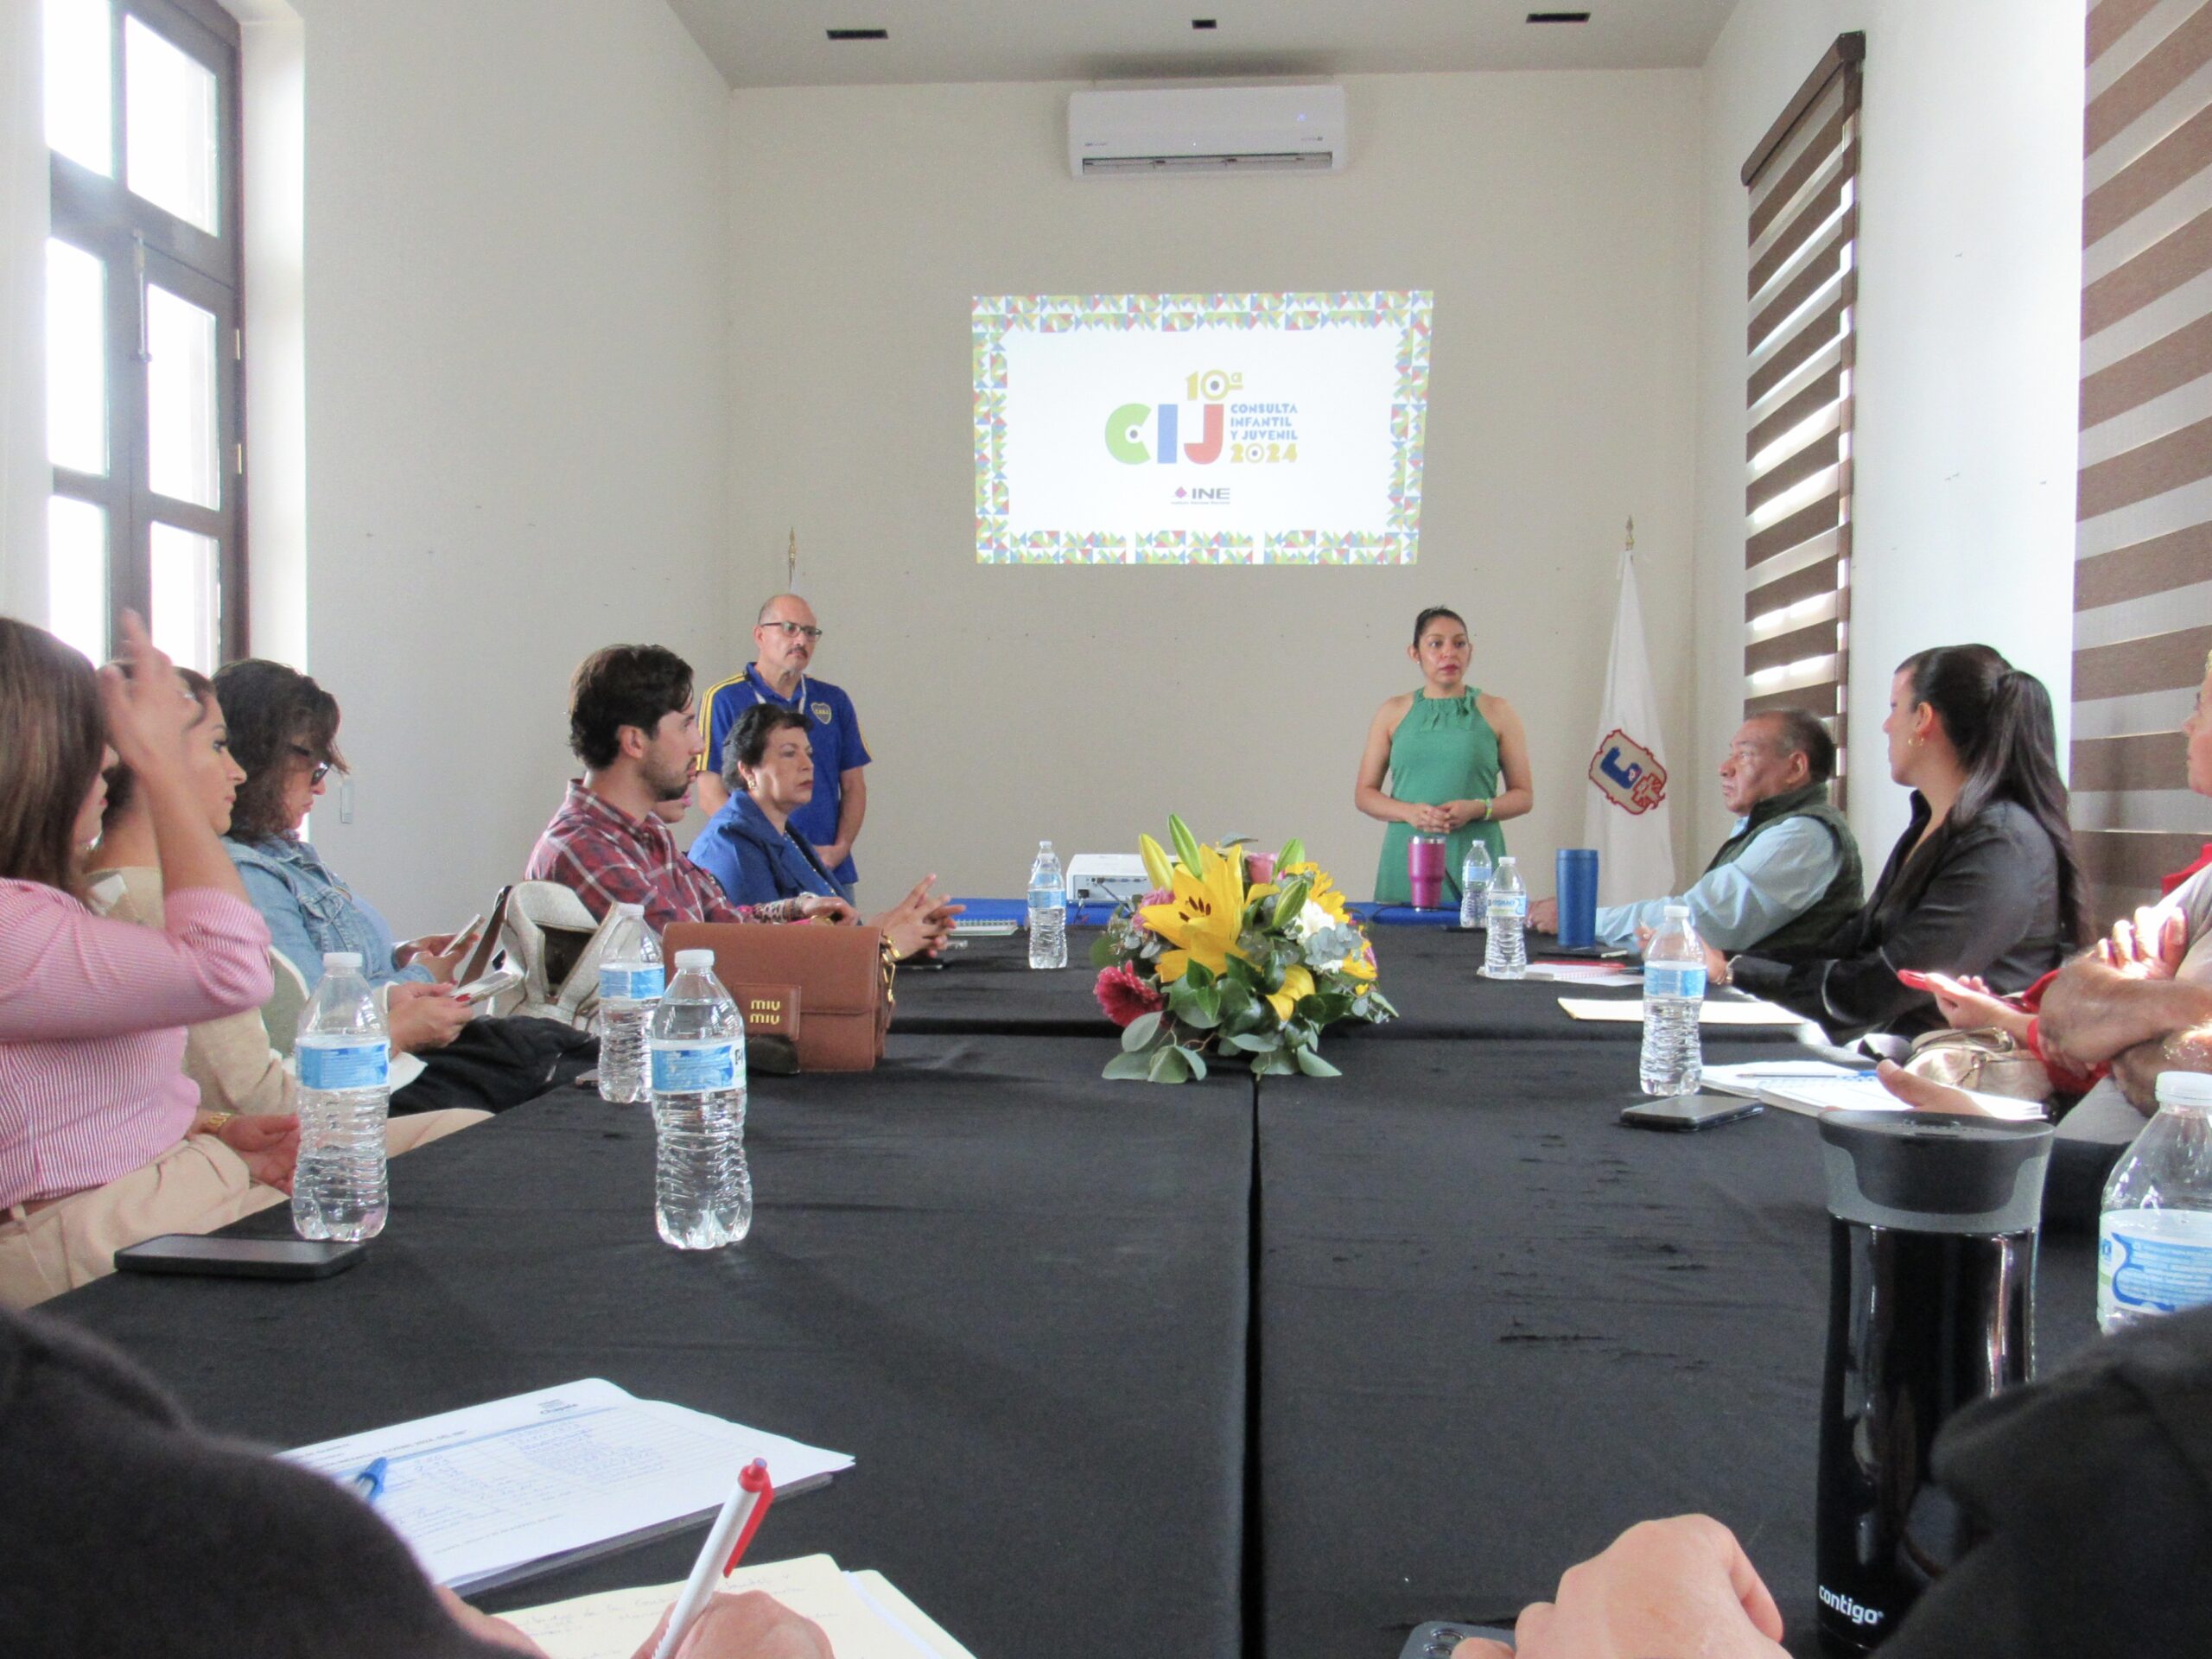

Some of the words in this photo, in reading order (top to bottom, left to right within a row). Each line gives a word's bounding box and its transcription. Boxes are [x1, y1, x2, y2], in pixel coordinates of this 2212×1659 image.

[1230, 404, 1298, 414] CONSULTA
[1230, 416, 1293, 427] INFANTIL
[1104, 403, 1224, 465] CIJ
[1230, 430, 1238, 440] Y
[1242, 430, 1298, 440] JUVENIL
[1230, 443, 1298, 463] 2024
[1192, 487, 1230, 499] INE
[751, 1000, 780, 1011] miu
[749, 1014, 779, 1025] miu
